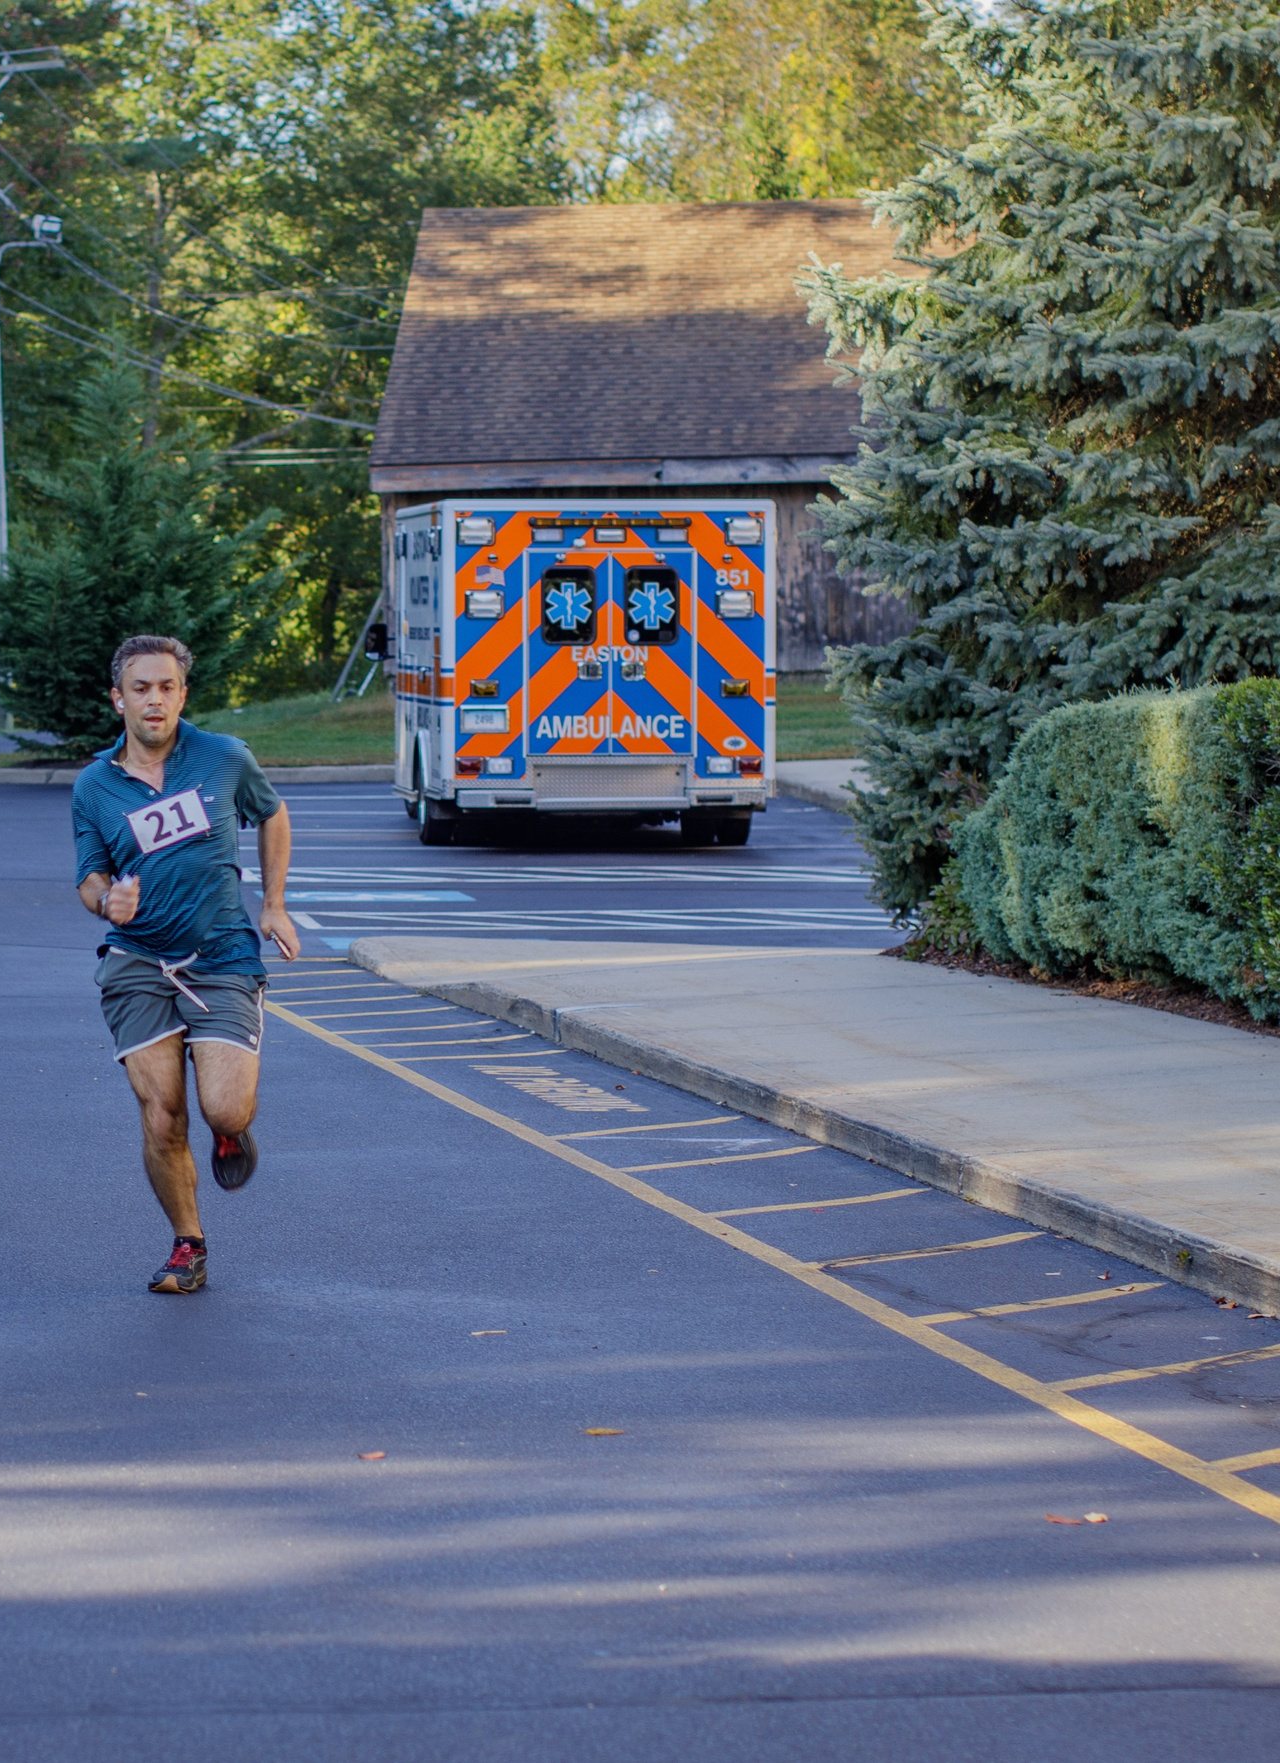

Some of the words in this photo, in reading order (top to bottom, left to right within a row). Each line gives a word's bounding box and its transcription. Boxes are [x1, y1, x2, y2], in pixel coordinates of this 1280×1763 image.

[715, 569, 749, 586] 851
[572, 646, 649, 662] EASTON
[536, 715, 685, 739] AMBULANCE
[144, 801, 194, 843] 21
[467, 1064, 560, 1077] NO
[496, 1077, 650, 1112] PARKING
